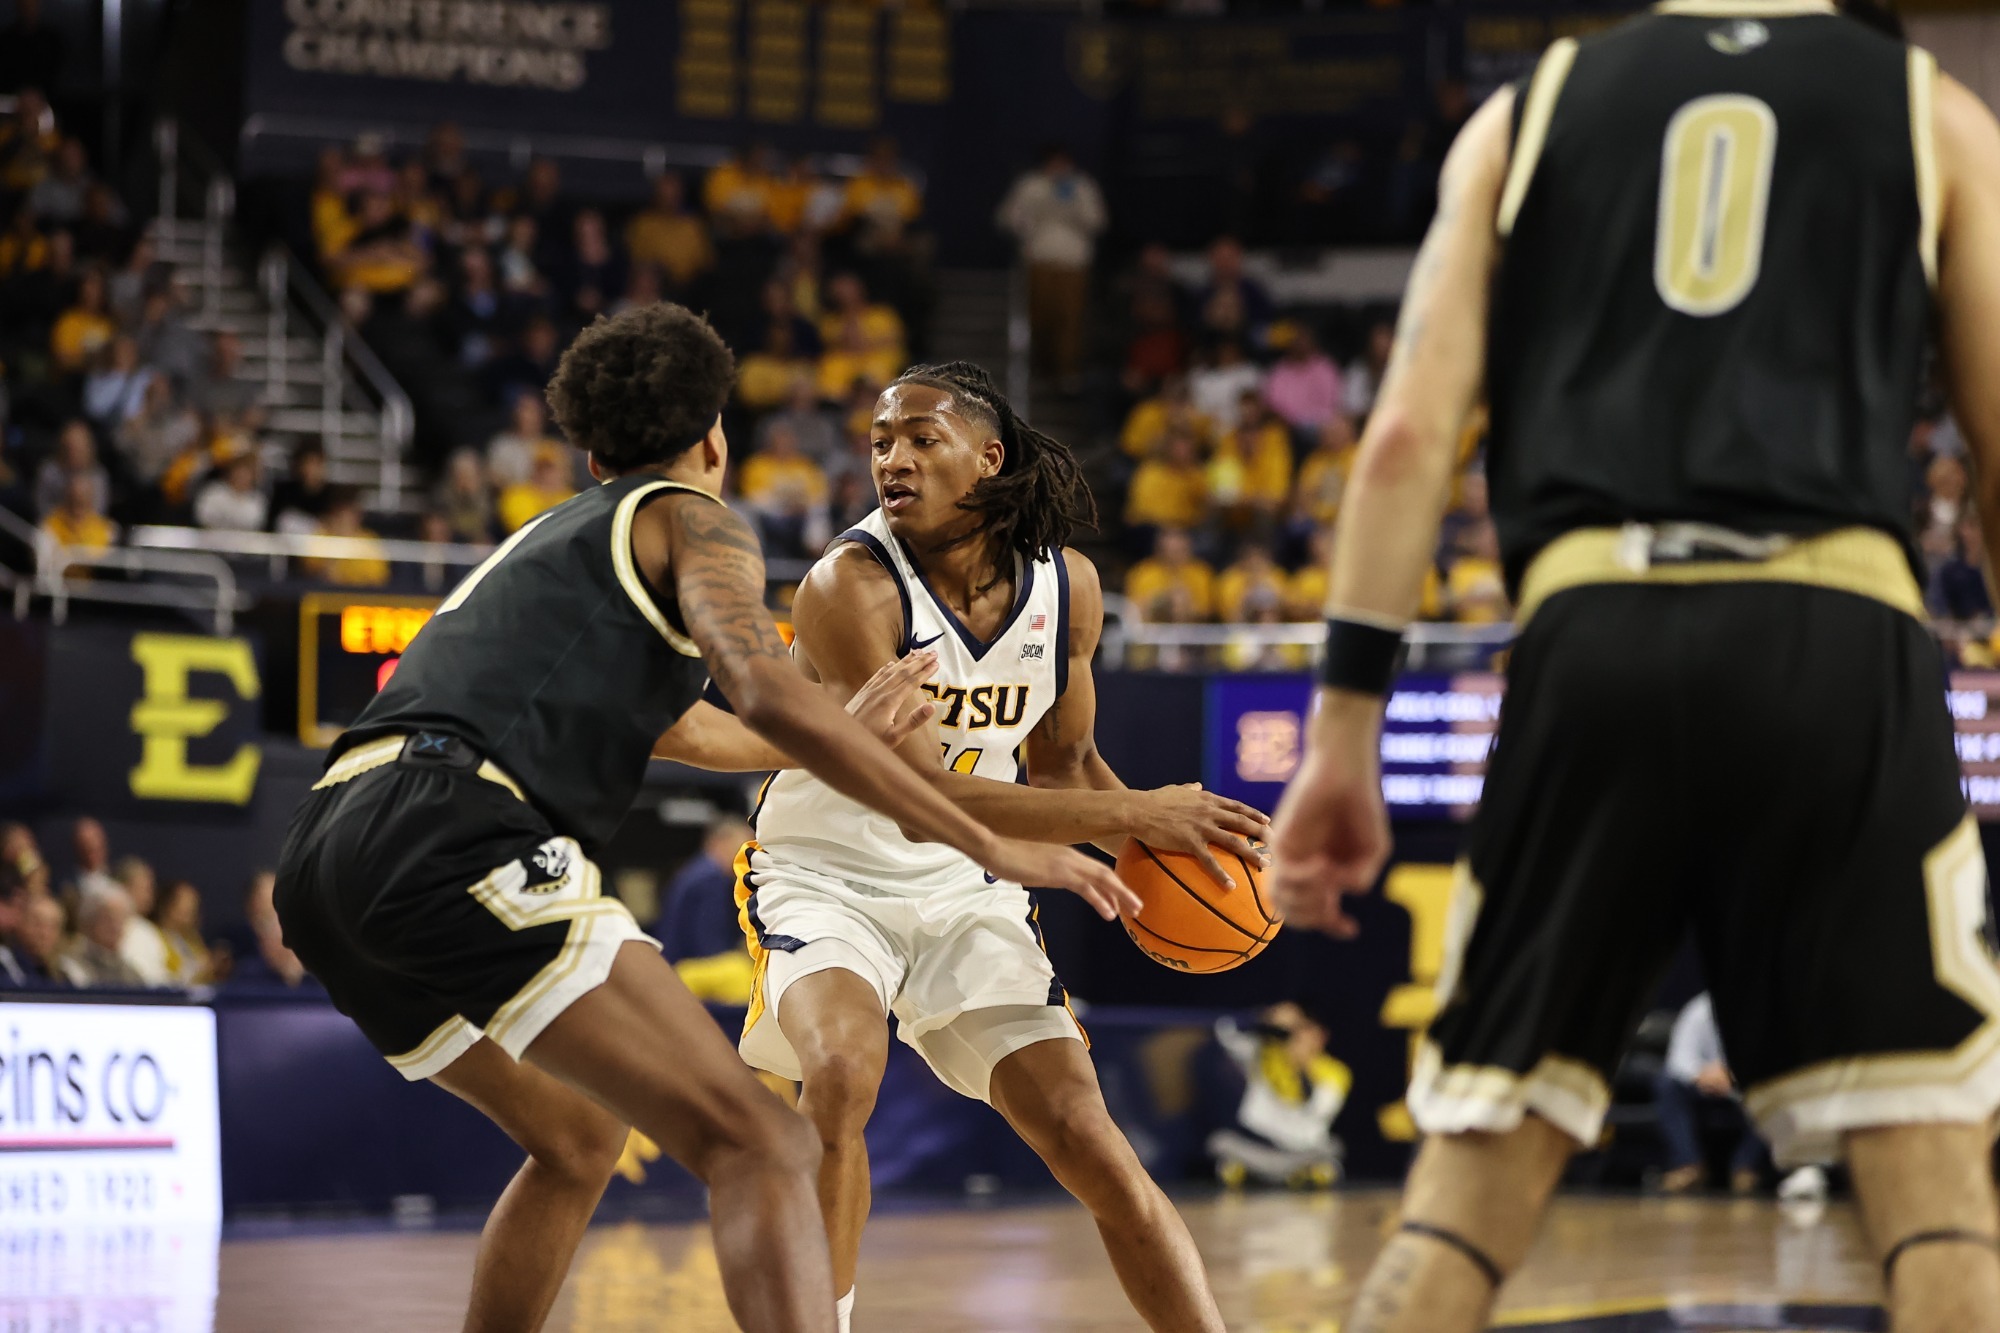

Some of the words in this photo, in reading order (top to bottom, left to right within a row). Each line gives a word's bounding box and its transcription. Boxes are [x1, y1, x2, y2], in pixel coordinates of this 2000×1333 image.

[284, 29, 588, 92] CHAMPIONS
[1654, 93, 1778, 318] 0
[130, 632, 262, 806] E
[0, 1027, 88, 1124] ins
